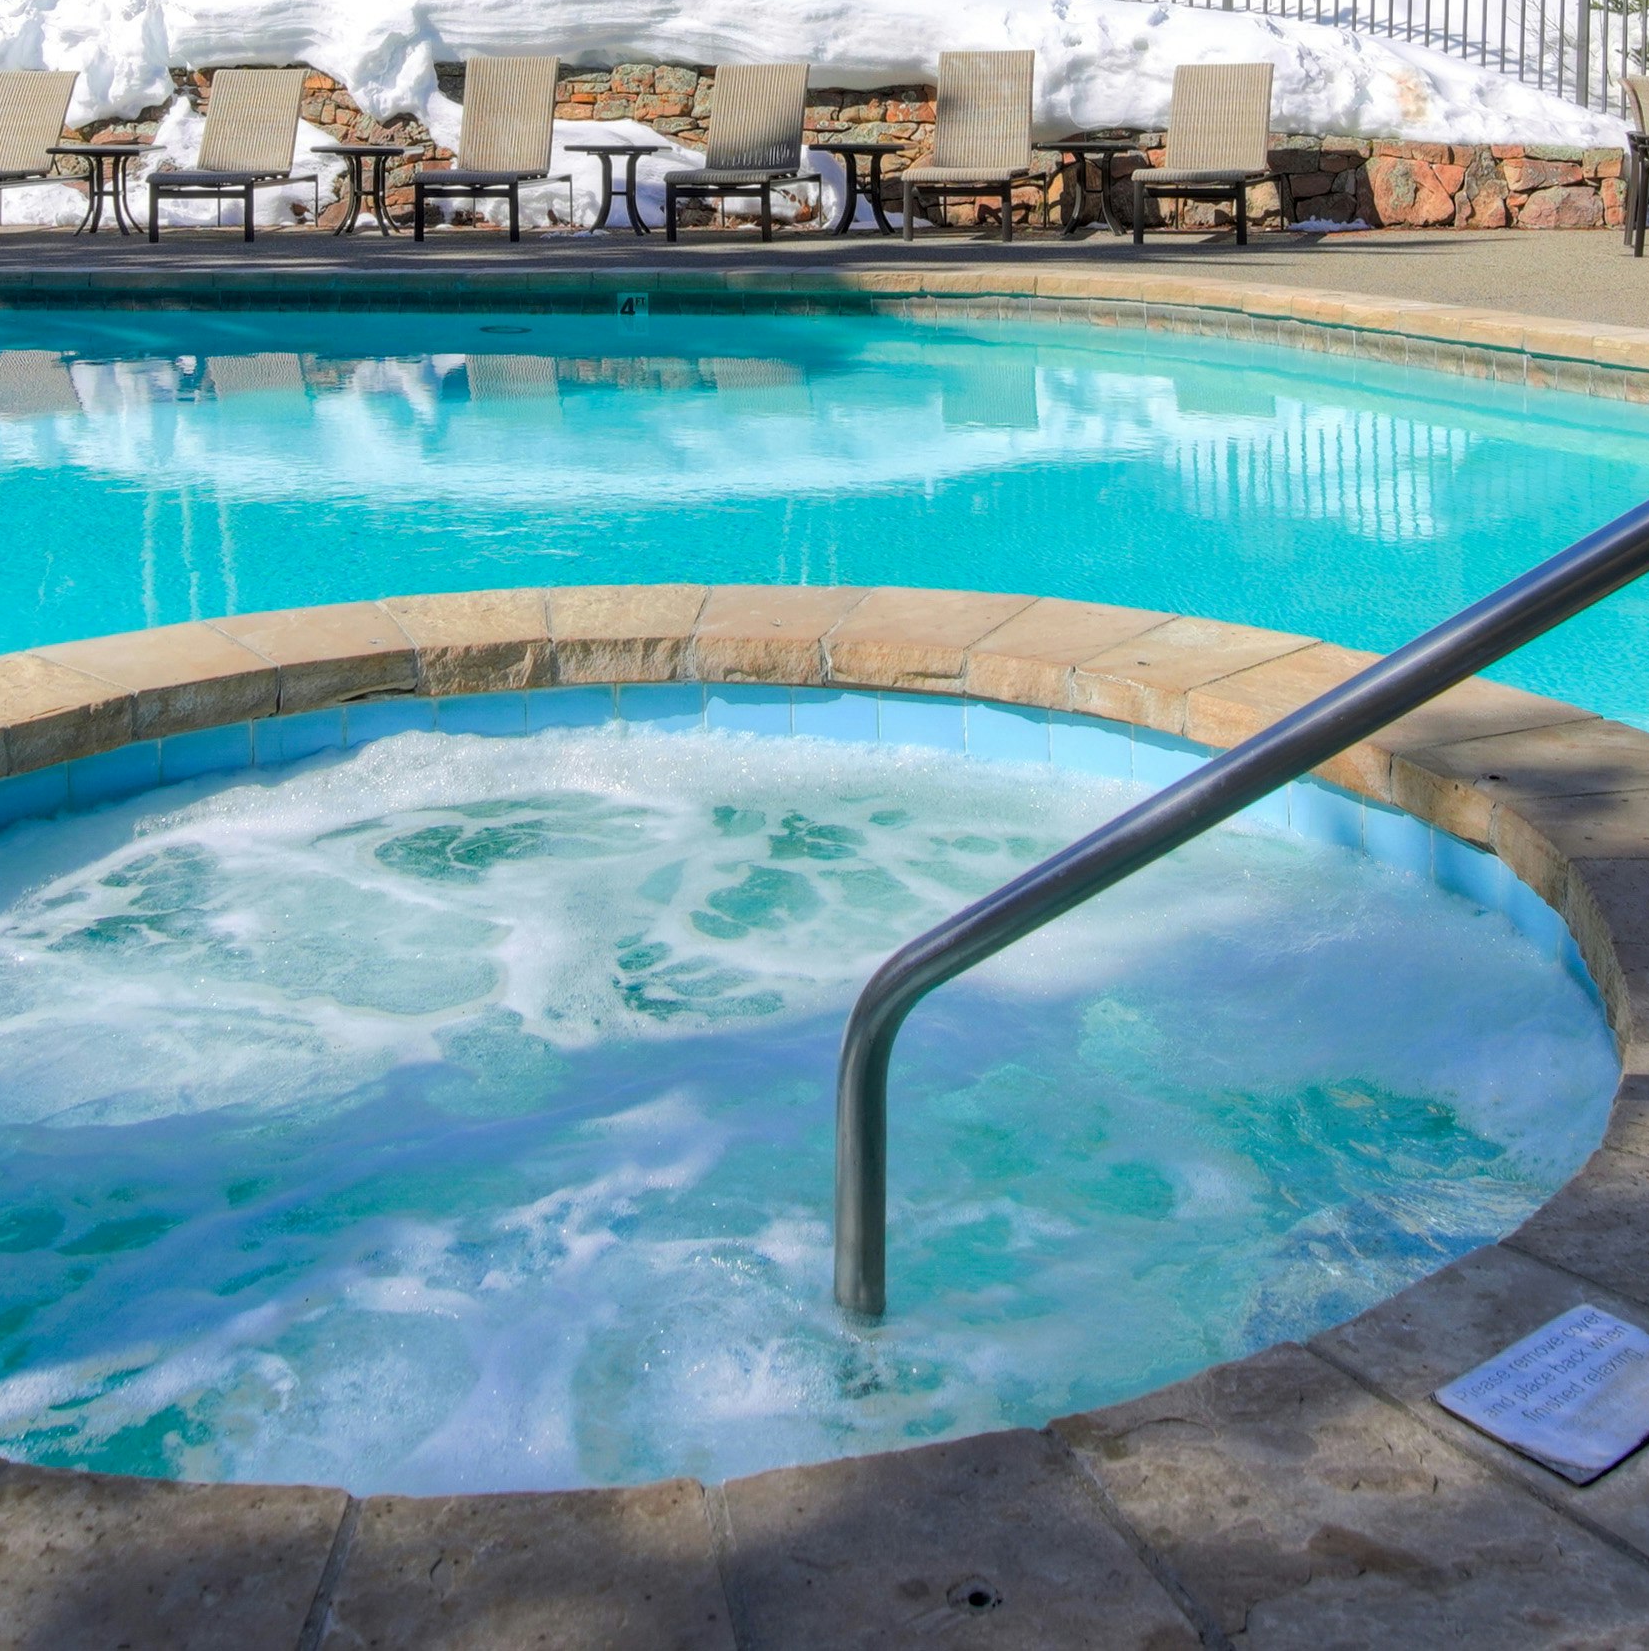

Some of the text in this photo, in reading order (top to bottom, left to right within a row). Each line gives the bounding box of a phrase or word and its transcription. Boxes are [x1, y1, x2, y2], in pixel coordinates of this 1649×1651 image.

[620, 297, 636, 316] 4
[1452, 1311, 1603, 1403] Please remove cover
[1483, 1325, 1630, 1419] and place back when
[1521, 1381, 1585, 1424] finished
